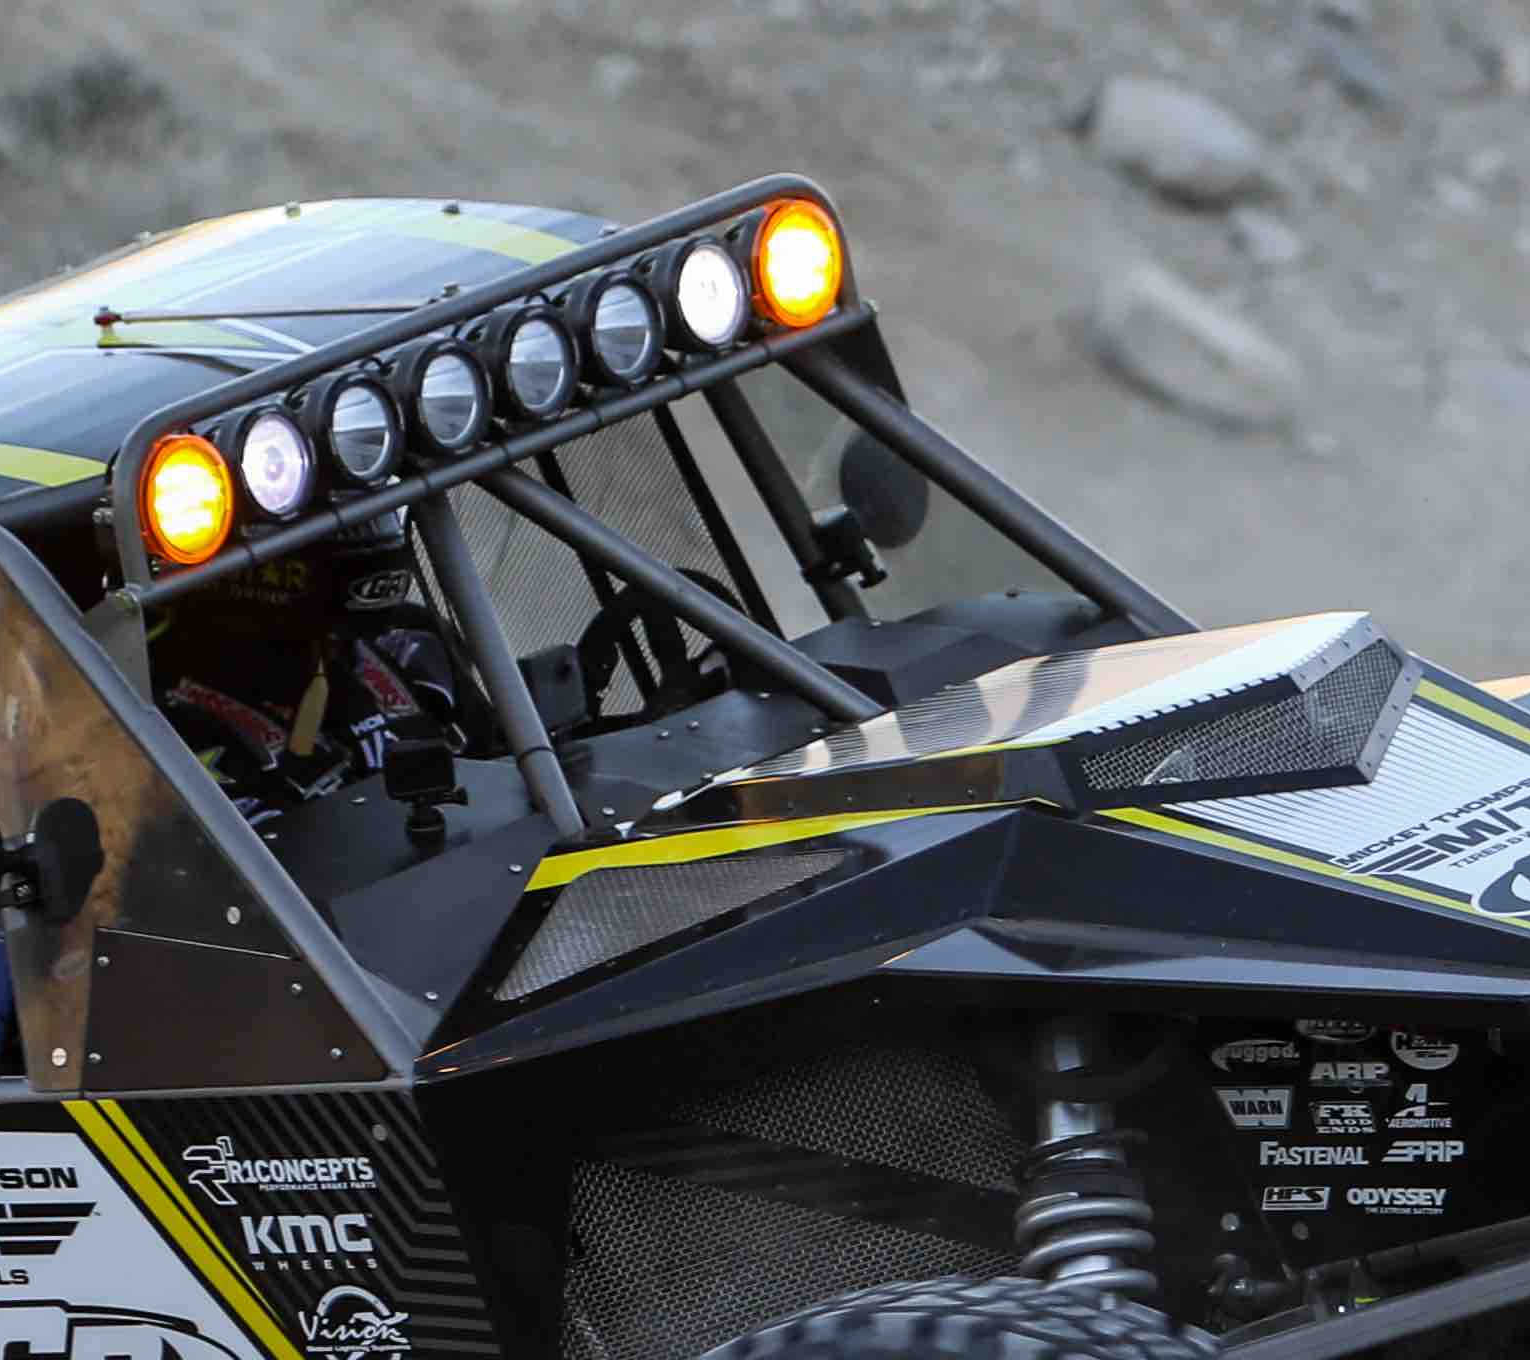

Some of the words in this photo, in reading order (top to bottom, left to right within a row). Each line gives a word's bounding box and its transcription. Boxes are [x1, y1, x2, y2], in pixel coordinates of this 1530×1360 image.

[1337, 822, 1430, 866] MICKEY
[1449, 843, 1506, 870] TIRES
[1309, 1061, 1390, 1080] ARP
[1228, 1100, 1283, 1116] WARN
[1318, 1104, 1371, 1117] FK
[1316, 1126, 1376, 1134] ENDS
[1328, 1118, 1373, 1126] ROD
[1388, 1118, 1452, 1129] AEROMOTIVE
[1259, 1141, 1369, 1166] FASTENAL
[1404, 1140, 1465, 1162] PRP
[228, 1157, 375, 1184] R1CONCEPTS
[1346, 1187, 1447, 1206] ODYSSEY
[251, 1258, 379, 1271] WHEELS
